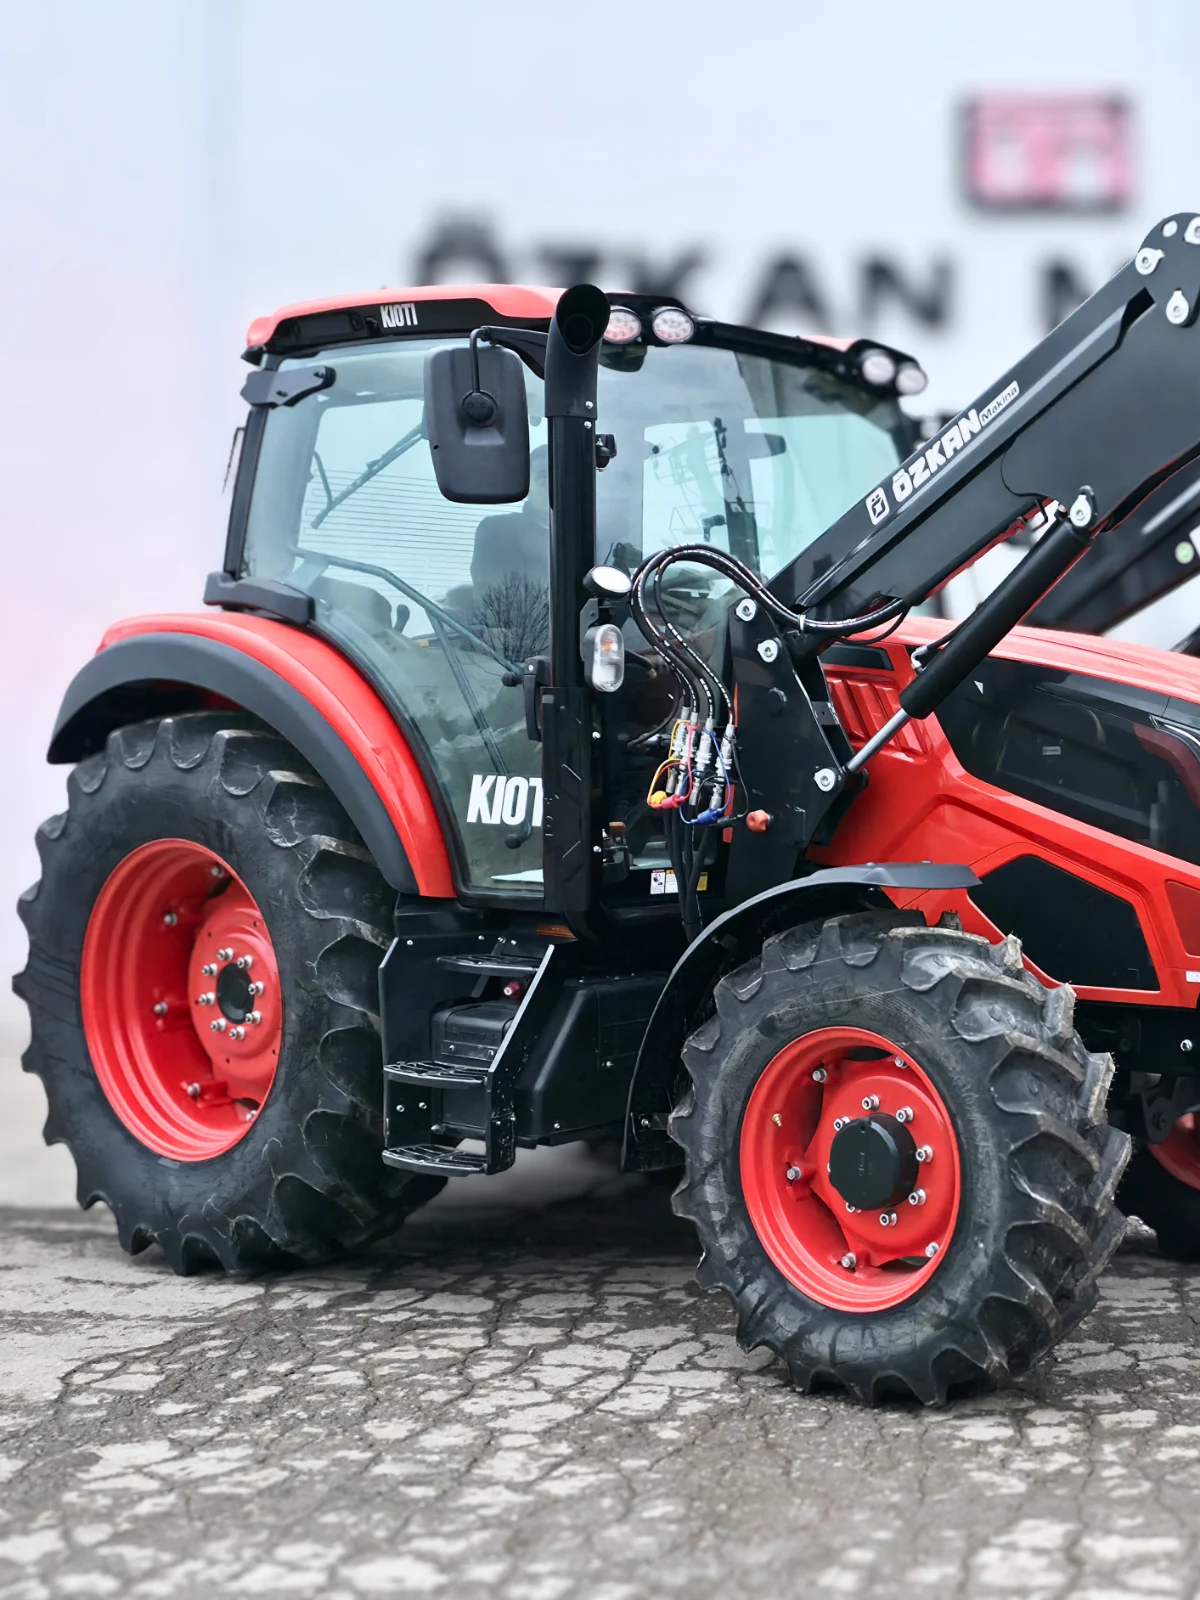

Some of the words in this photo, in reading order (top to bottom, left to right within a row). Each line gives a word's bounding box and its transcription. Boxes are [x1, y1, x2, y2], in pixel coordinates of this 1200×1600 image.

[380, 303, 418, 328] KIOTI
[892, 408, 982, 503] ÖZKAN
[981, 387, 1018, 422] Makina
